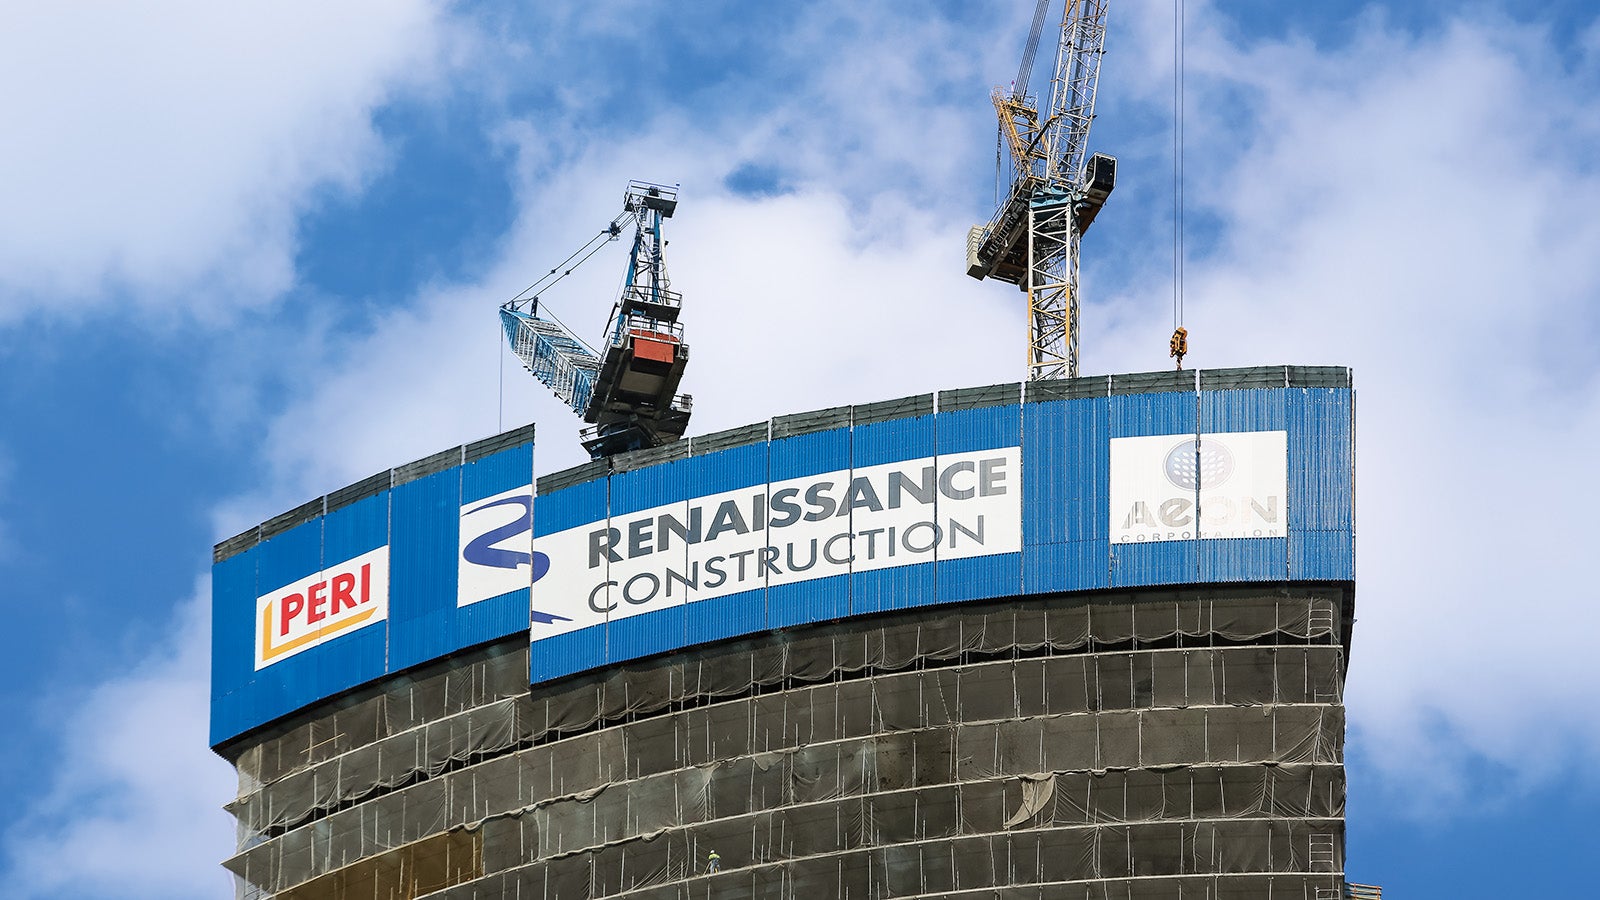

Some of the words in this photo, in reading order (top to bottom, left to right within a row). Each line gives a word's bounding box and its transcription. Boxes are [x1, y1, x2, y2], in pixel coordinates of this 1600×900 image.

[588, 457, 1007, 569] RENAISSANCE
[280, 563, 371, 637] PERI
[588, 514, 985, 613] CONSTRUCTION
